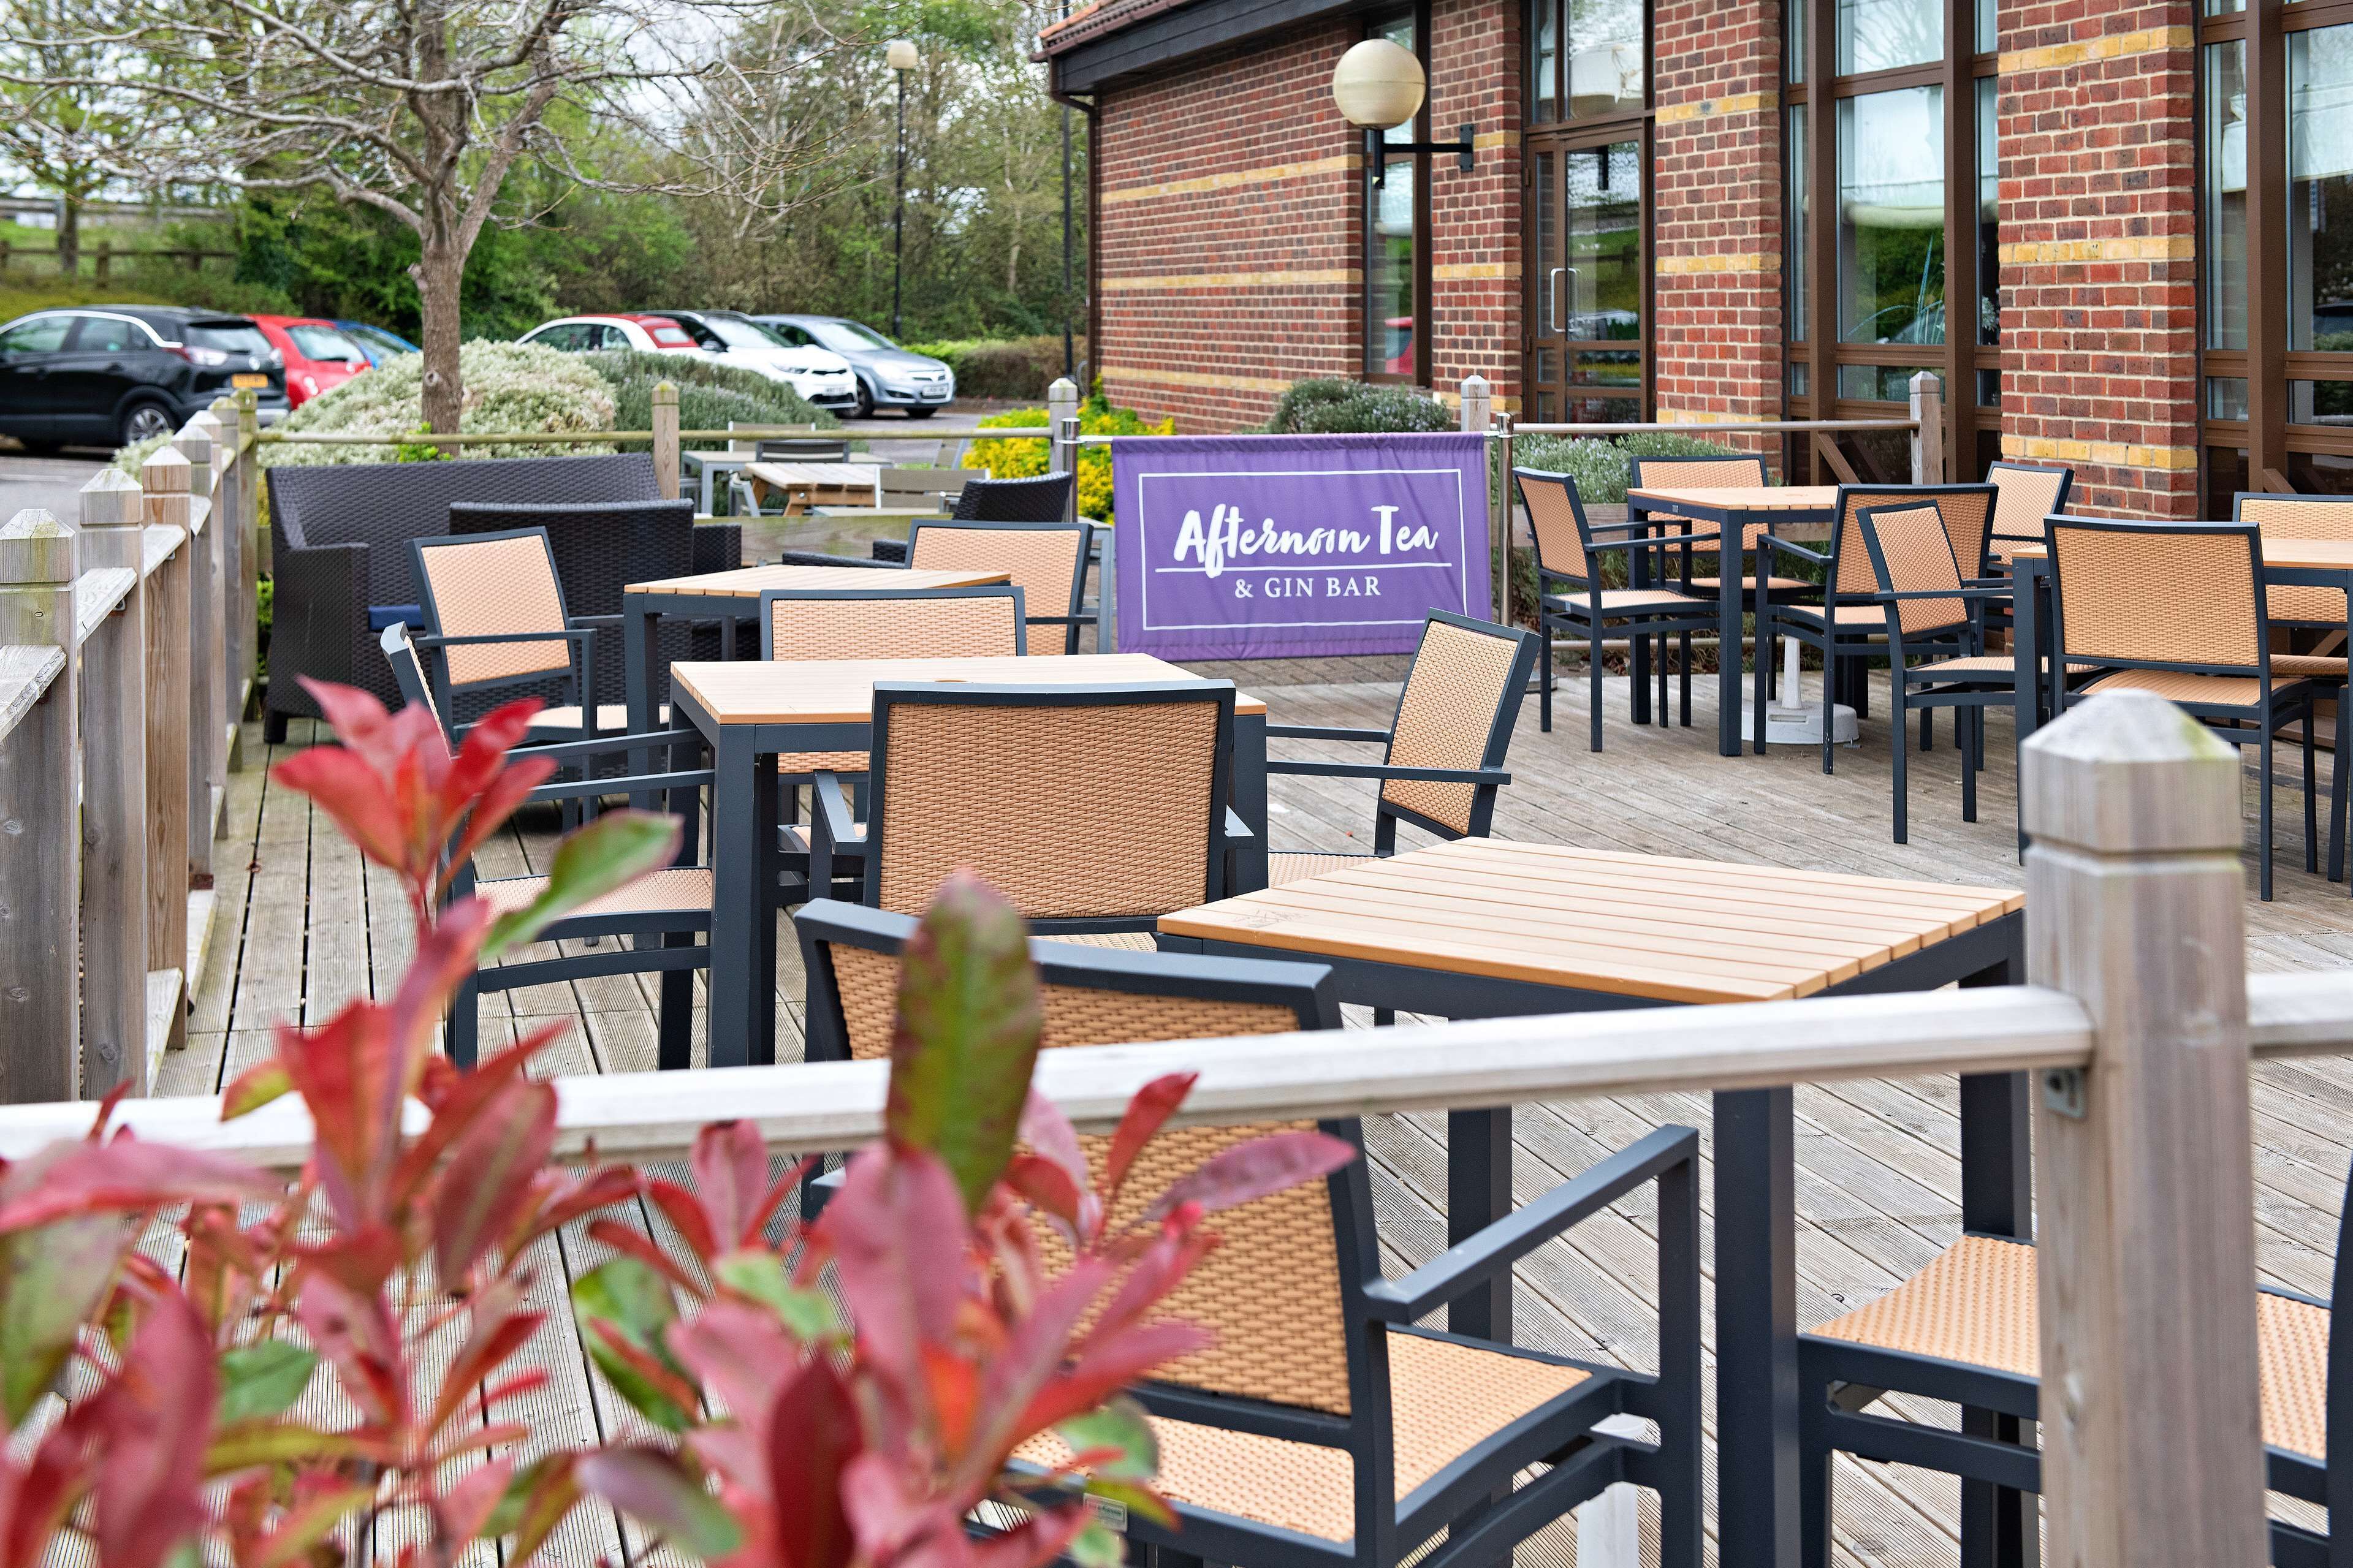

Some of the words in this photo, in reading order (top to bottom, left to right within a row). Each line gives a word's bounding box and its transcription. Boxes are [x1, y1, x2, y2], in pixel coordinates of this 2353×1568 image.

[1173, 504, 1371, 578] Afternoon
[1370, 505, 1439, 555] Tea
[1234, 578, 1254, 599] &
[1264, 577, 1313, 598] GIN
[1326, 576, 1381, 597] BAR
